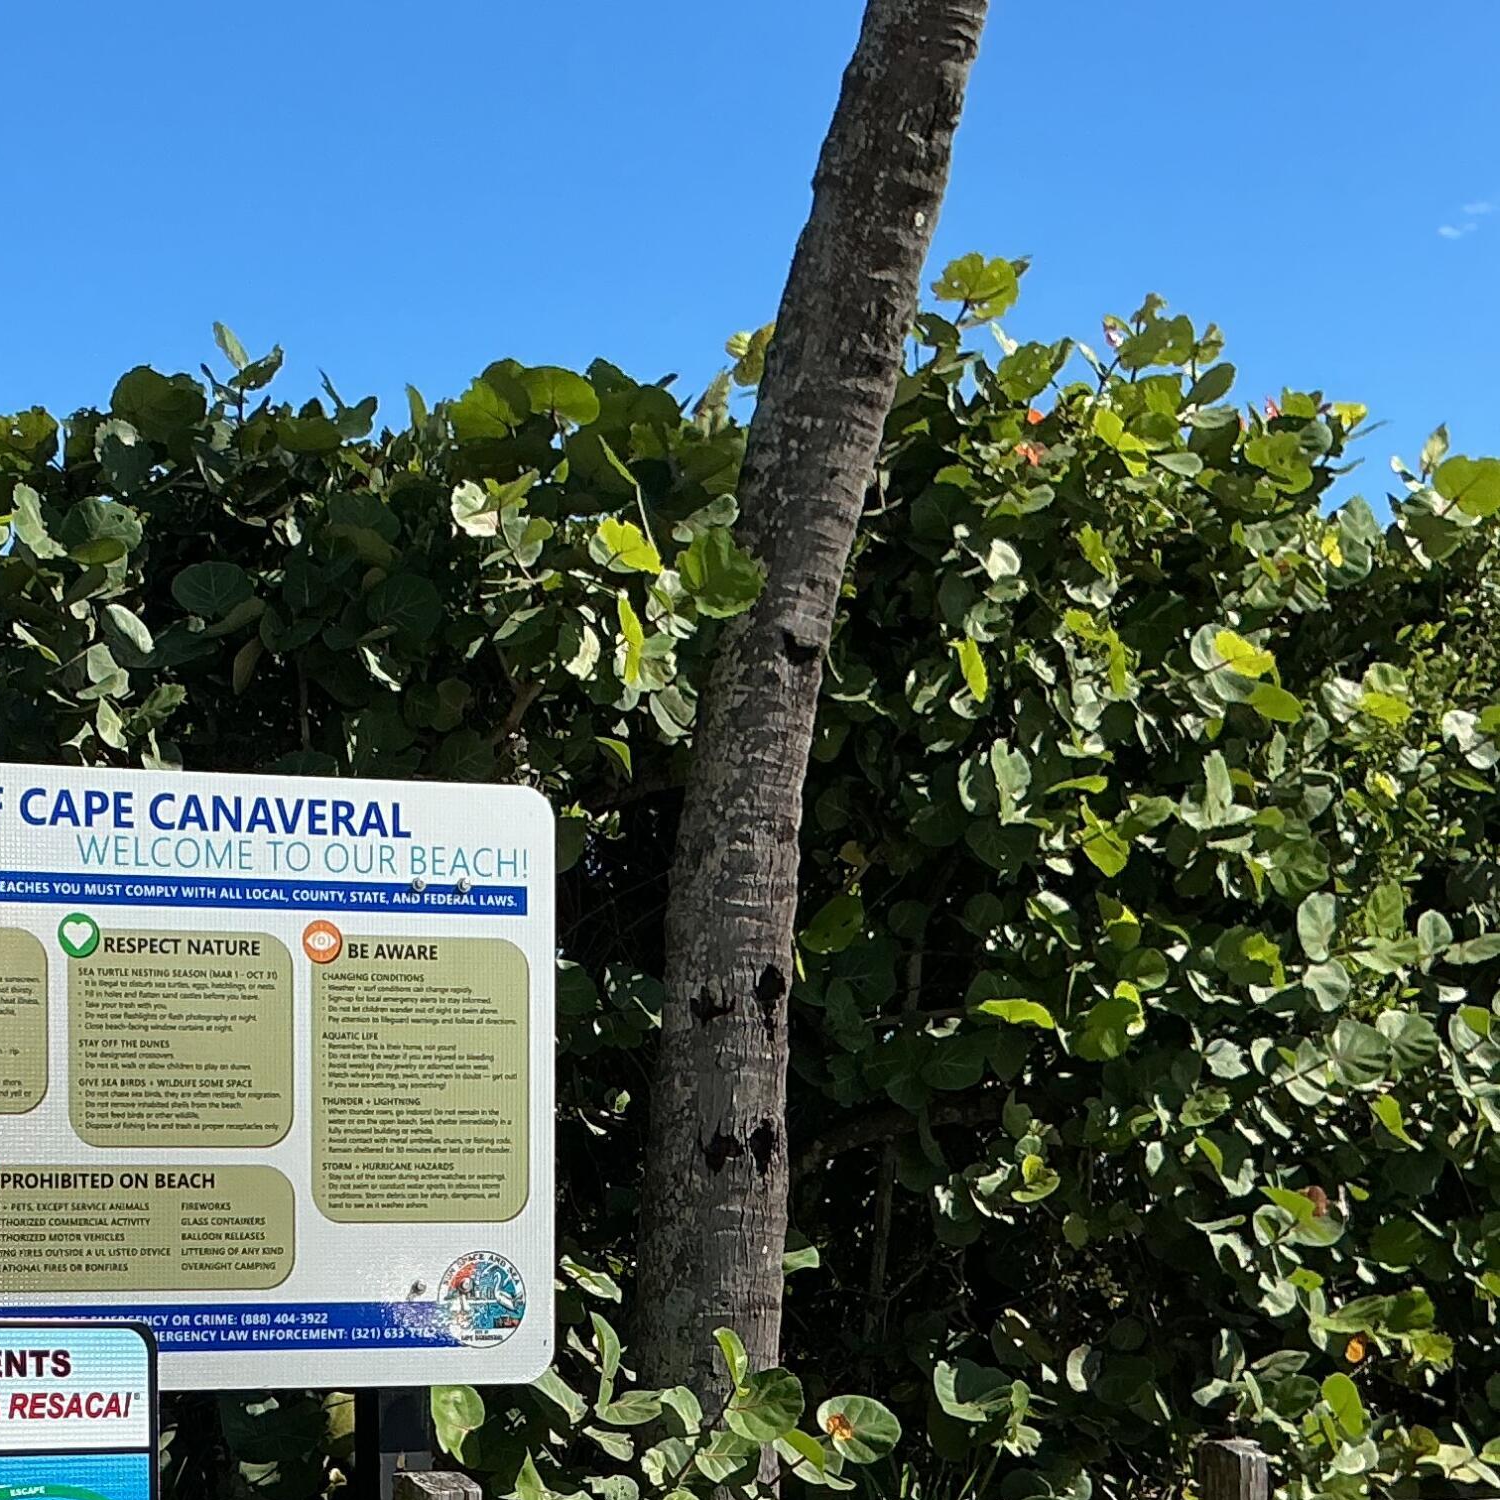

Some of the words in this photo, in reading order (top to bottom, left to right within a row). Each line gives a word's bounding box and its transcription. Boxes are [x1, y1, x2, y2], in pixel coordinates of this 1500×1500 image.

[20, 789, 134, 828] CAPE
[149, 793, 412, 838] CANAVERAL
[76, 834, 253, 870] WELCOME
[267, 841, 310, 871] TO
[324, 842, 397, 875] OUR
[410, 847, 528, 879] BEACH!
[53, 882, 80, 895] YOU
[84, 884, 121, 897] MUST
[125, 885, 178, 897] COMPLY
[181, 887, 217, 899] WITH
[220, 888, 242, 900] ALL
[246, 889, 289, 902] LOCAL,
[293, 890, 347, 904] COUNTY,
[350, 892, 389, 905] STATE,
[393, 893, 420, 904] AND
[424, 894, 476, 906] FEDERAL
[480, 895, 517, 907] LAWS.
[103, 937, 181, 954] RESPECT
[188, 939, 260, 956] NATURE
[348, 943, 368, 959] BE
[374, 944, 438, 960] AWARE
[78, 1040, 98, 1048] STAY
[101, 1040, 118, 1048] OFF
[121, 1040, 137, 1048] THE
[140, 1040, 169, 1048] DUNES
[1, 1173, 114, 1189] PROHIBITED
[120, 1173, 148, 1189] ON
[155, 1173, 215, 1189] BEACH
[181, 1203, 231, 1211] FIREWORKS
[181, 1217, 208, 1226] GLASS
[211, 1217, 266, 1226] CONTAINERS
[181, 1233, 222, 1241] BALLOON
[225, 1232, 265, 1241] RELEASES
[172, 1315, 190, 1325] OR
[194, 1314, 237, 1325] CRIME:
[241, 1314, 270, 1326] (888)
[274, 1313, 327, 1324] 404-3922
[221, 1330, 247, 1340] LAW
[253, 1329, 348, 1340] ENFORCEMENT:
[352, 1327, 380, 1340] (321)
[10, 1486, 45, 1496] ESCAPE
